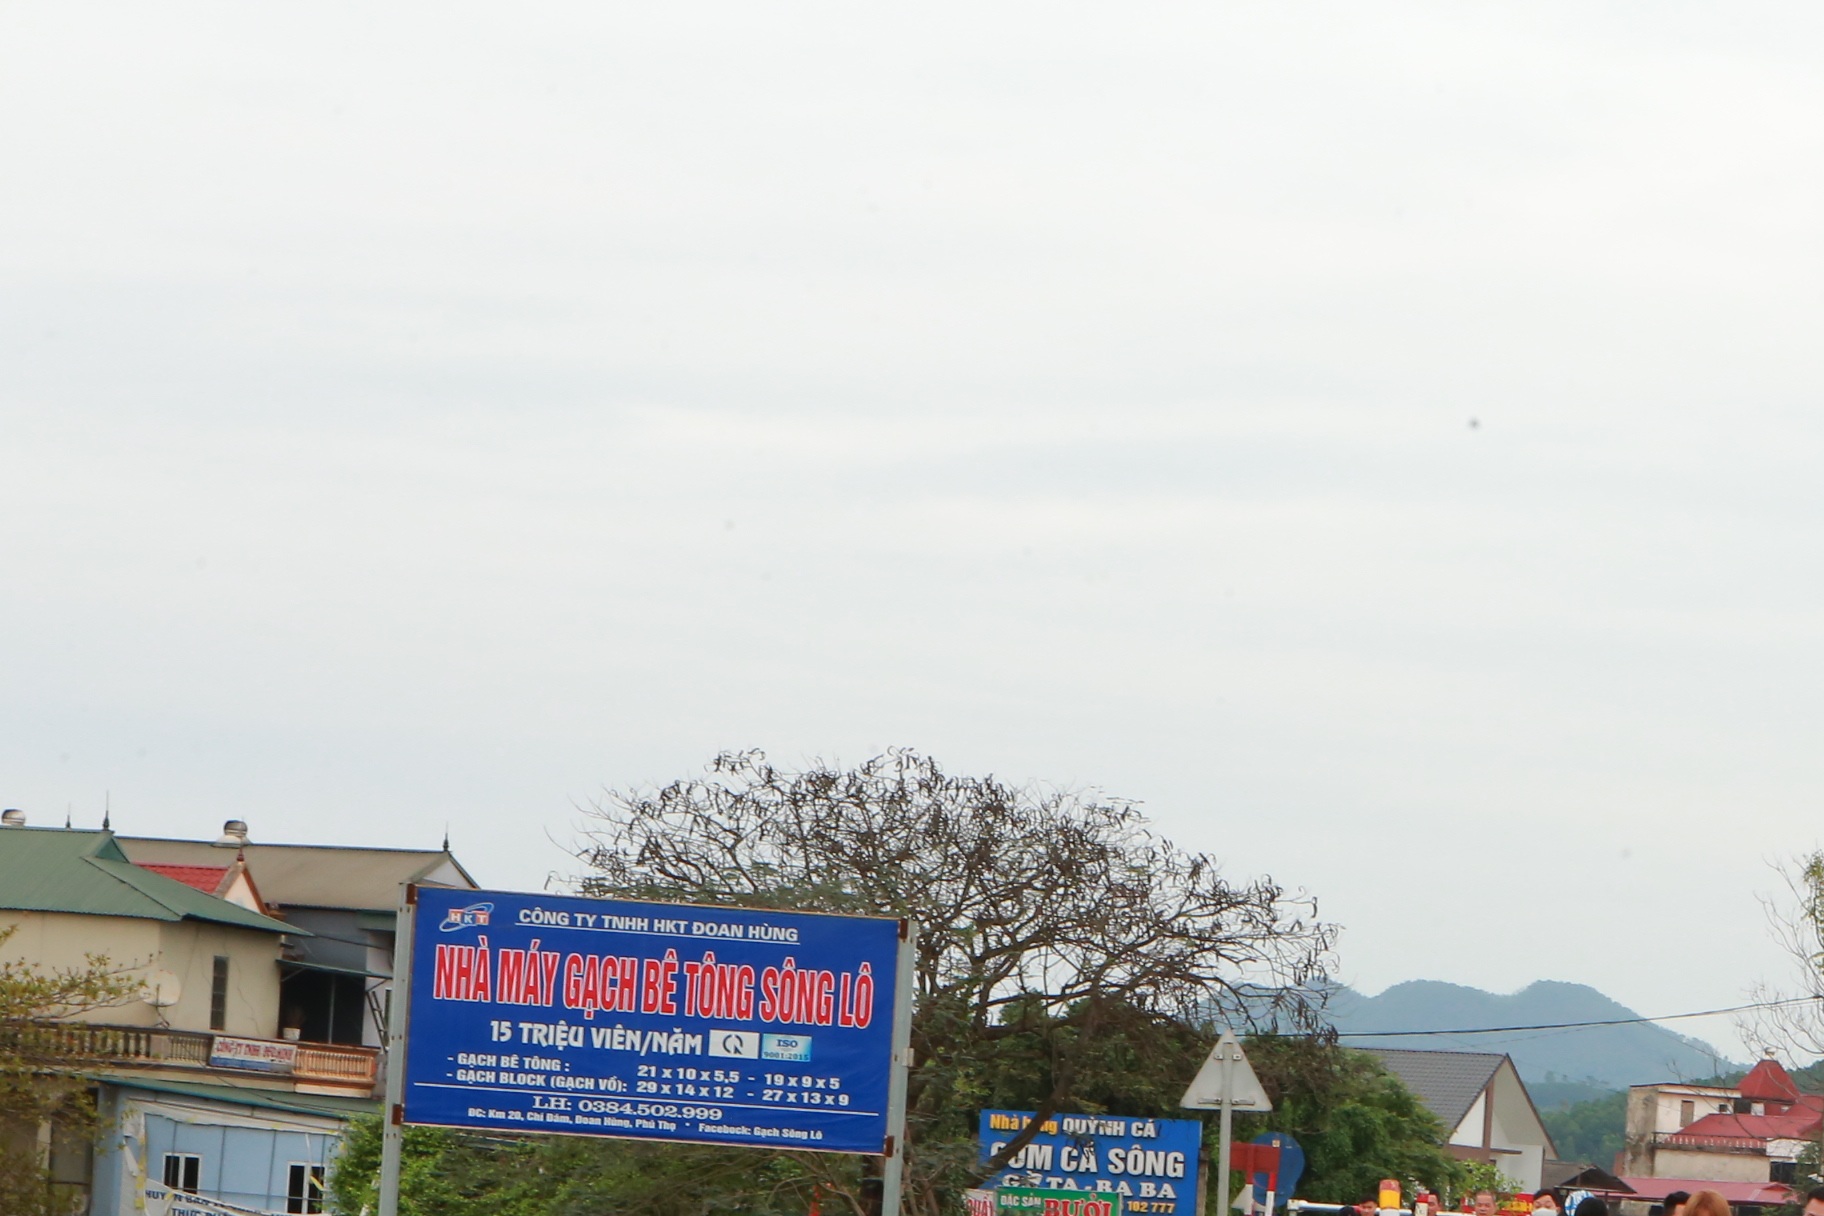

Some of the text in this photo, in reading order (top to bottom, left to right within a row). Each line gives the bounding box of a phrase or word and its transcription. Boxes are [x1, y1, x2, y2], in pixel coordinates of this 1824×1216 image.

[450, 909, 489, 926] HKT
[519, 907, 799, 942] CÔNG TY TNHH HKT ĐOAN HÙNG
[433, 935, 874, 1029] NHÀ MÁY GẠCH BÊ TÔNG SÔNG LÔ
[490, 1020, 702, 1057] 15 TRIỆU VIÊN/NĂM
[776, 1039, 798, 1049] ISO
[763, 1051, 809, 1061] 9001:2015
[457, 1052, 497, 1068] GẠCH
[500, 1054, 519, 1069] BÊ
[523, 1056, 562, 1072] TÔNG
[637, 1065, 656, 1077] 21
[677, 1067, 697, 1081] 10
[713, 1071, 740, 1084] 5,5
[765, 1073, 785, 1087] 19
[801, 1076, 813, 1088] 9
[829, 1077, 840, 1090] 5
[456, 1069, 496, 1085] GẠCH
[499, 1072, 546, 1087] BLOCK
[550, 1076, 595, 1091] (GẠCH
[636, 1081, 657, 1093] 29
[676, 1083, 696, 1096] 14
[713, 1086, 734, 1099] 12
[762, 1089, 783, 1102] 27
[801, 1092, 821, 1105] 13
[838, 1094, 850, 1106] 9
[532, 1095, 722, 1121] LH: 0384.502.999
[990, 1113, 1019, 1131] Nhà
[488, 1109, 506, 1120] Km
[508, 1111, 525, 1122] 20,
[658, 1120, 677, 1132] Thọ
[753, 1127, 780, 1140] Gạch
[1107, 1144, 1185, 1178] SÔNG
[1096, 1179, 1133, 1196] BA
[1139, 1181, 1177, 1199] BA
[1128, 1200, 1150, 1213] 102
[1151, 1202, 1176, 1214] 777
